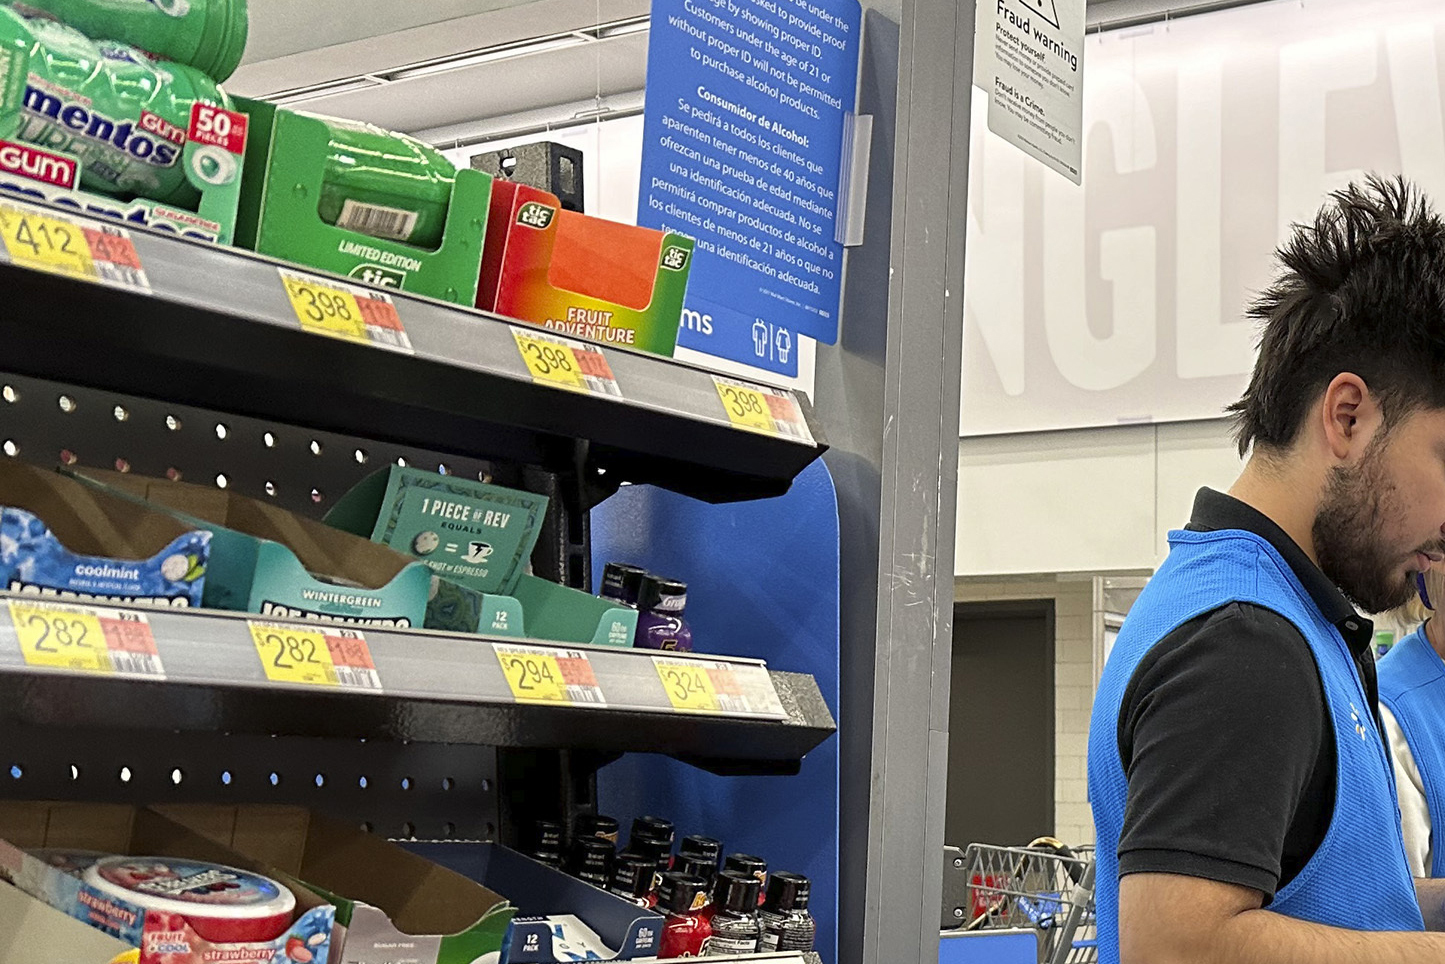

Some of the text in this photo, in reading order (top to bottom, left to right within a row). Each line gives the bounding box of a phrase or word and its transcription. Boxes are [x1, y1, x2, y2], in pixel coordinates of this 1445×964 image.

[728, 3, 823, 60] by showing proper ID.
[778, 6, 846, 51] to provide proof
[809, 3, 849, 33] under the
[684, 1, 831, 84] Customers under the age of 21 or
[996, 22, 1046, 64] Protect yourself.
[997, 0, 1030, 35] Fraud
[1033, 27, 1078, 72] warning
[668, 15, 842, 110] without proper ID will not be permitted
[690, 47, 820, 119] to purchase alcohol products.
[995, 76, 1013, 95] Fraud
[1014, 88, 1019, 99] is
[1025, 96, 1045, 116] Crime.
[23, 85, 179, 166] mentos
[196, 108, 231, 137] 50
[697, 86, 810, 148] Consumidor de Alcohol:
[678, 99, 824, 175] Se pedirá a todos los clientes que
[662, 115, 834, 200] aparenten tener menos de 40 años que
[660, 136, 833, 219] ofrezcan una prueba de edad mediante
[529, 203, 550, 216] tic
[670, 162, 822, 235] una identificación adecuada. No se
[521, 213, 547, 228] tac
[652, 177, 834, 260] permitirá comprar productos de alcohol a
[649, 195, 663, 211] los
[665, 203, 701, 226] clientes
[703, 217, 716, 231] de
[718, 224, 747, 245] menos
[750, 236, 761, 250] de
[763, 241, 773, 254] 21
[775, 248, 796, 266] años
[797, 258, 803, 267] o
[805, 261, 821, 277] que
[822, 269, 834, 280] no
[338, 240, 422, 272] LIMITED EDITION
[664, 255, 682, 267] tac
[669, 249, 684, 260] tic
[697, 239, 820, 295] una identificación adecuada.
[544, 318, 635, 345] ADVENTURE
[567, 307, 613, 327] FRUIT
[421, 498, 511, 530] 1 PIECE REV
[440, 521, 483, 535] EQUALS
[75, 564, 139, 580] coolmint
[454, 563, 489, 579] ESPRESSO
[303, 589, 382, 607] WINTERGREEN
[492, 621, 508, 630] PACK
[496, 611, 508, 622] 12
[78, 890, 137, 925] strawberry
[150, 933, 183, 942] FRUIT
[527, 934, 538, 943] 12
[203, 948, 276, 961] strawberry
